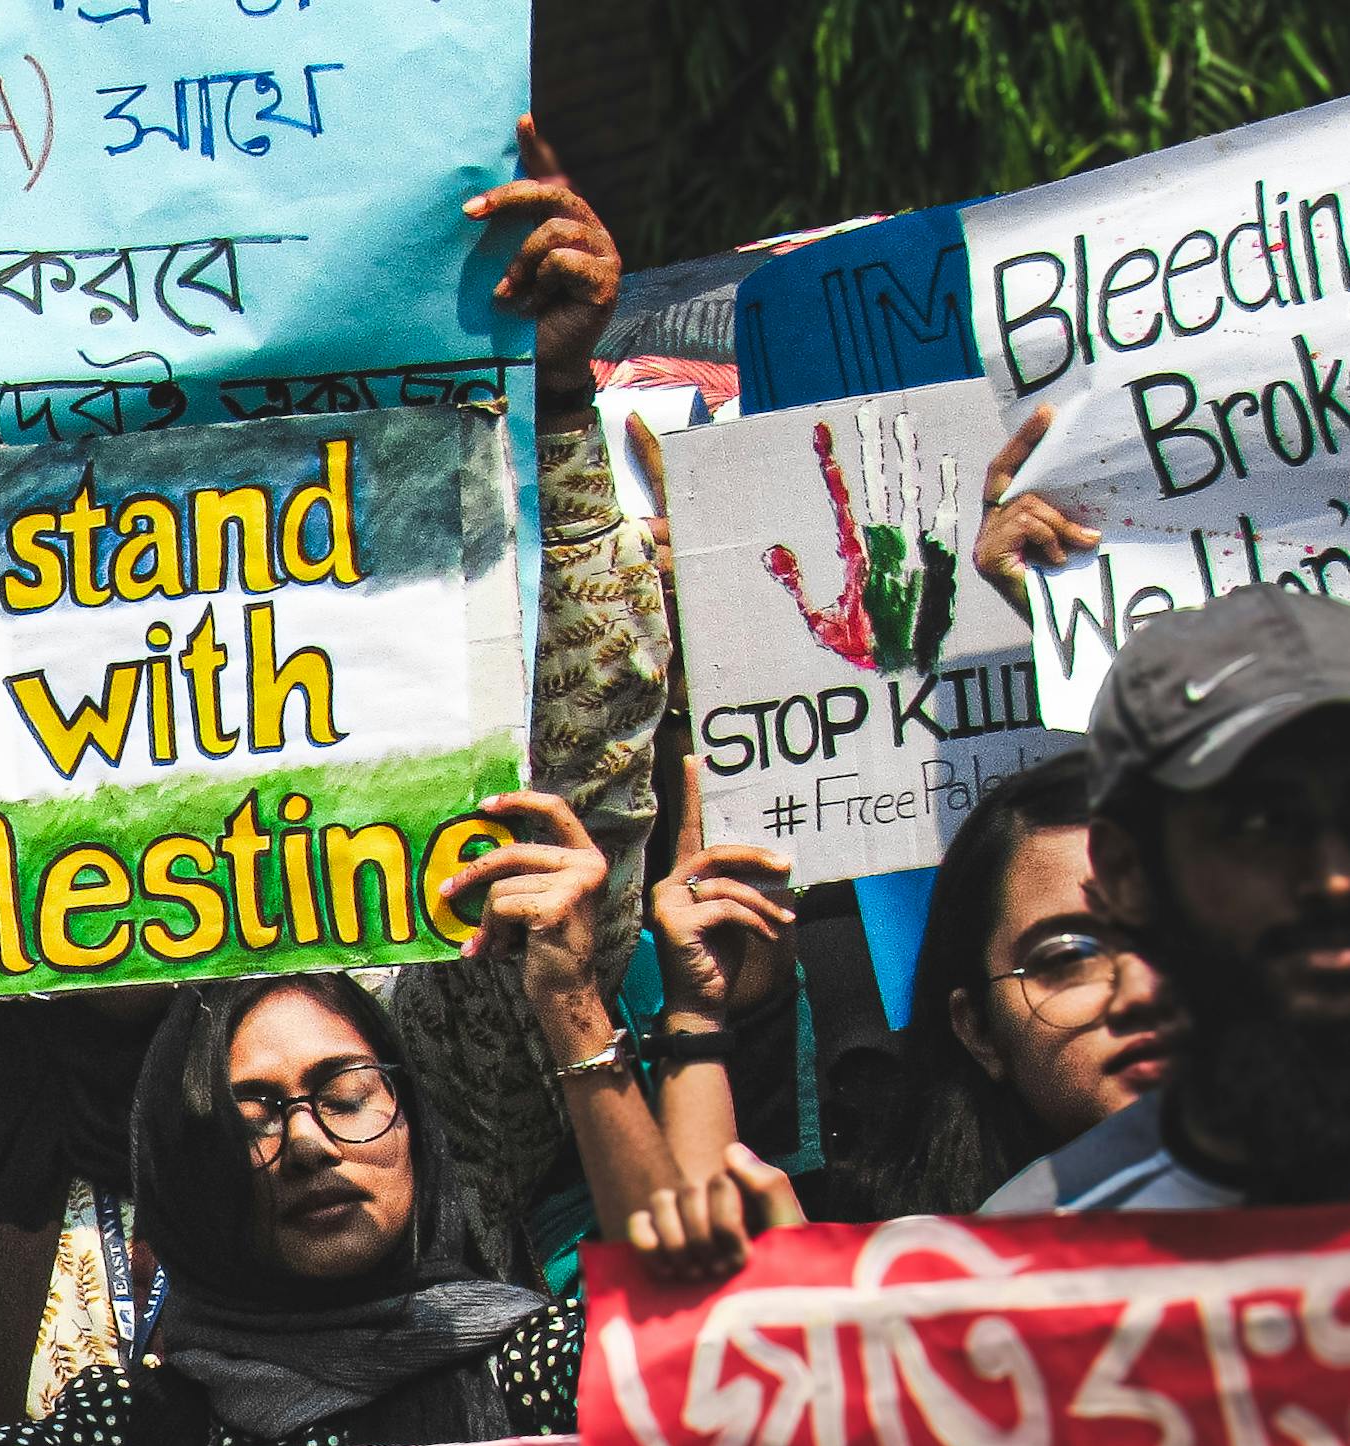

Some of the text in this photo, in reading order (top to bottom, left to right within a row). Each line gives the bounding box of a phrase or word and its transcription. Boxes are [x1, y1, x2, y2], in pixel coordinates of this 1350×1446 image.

[992, 180, 1350, 399] Bleedin
[1130, 334, 1350, 500] Brok
[3, 600, 350, 779] with
[700, 660, 1041, 777] STOP KILLI
